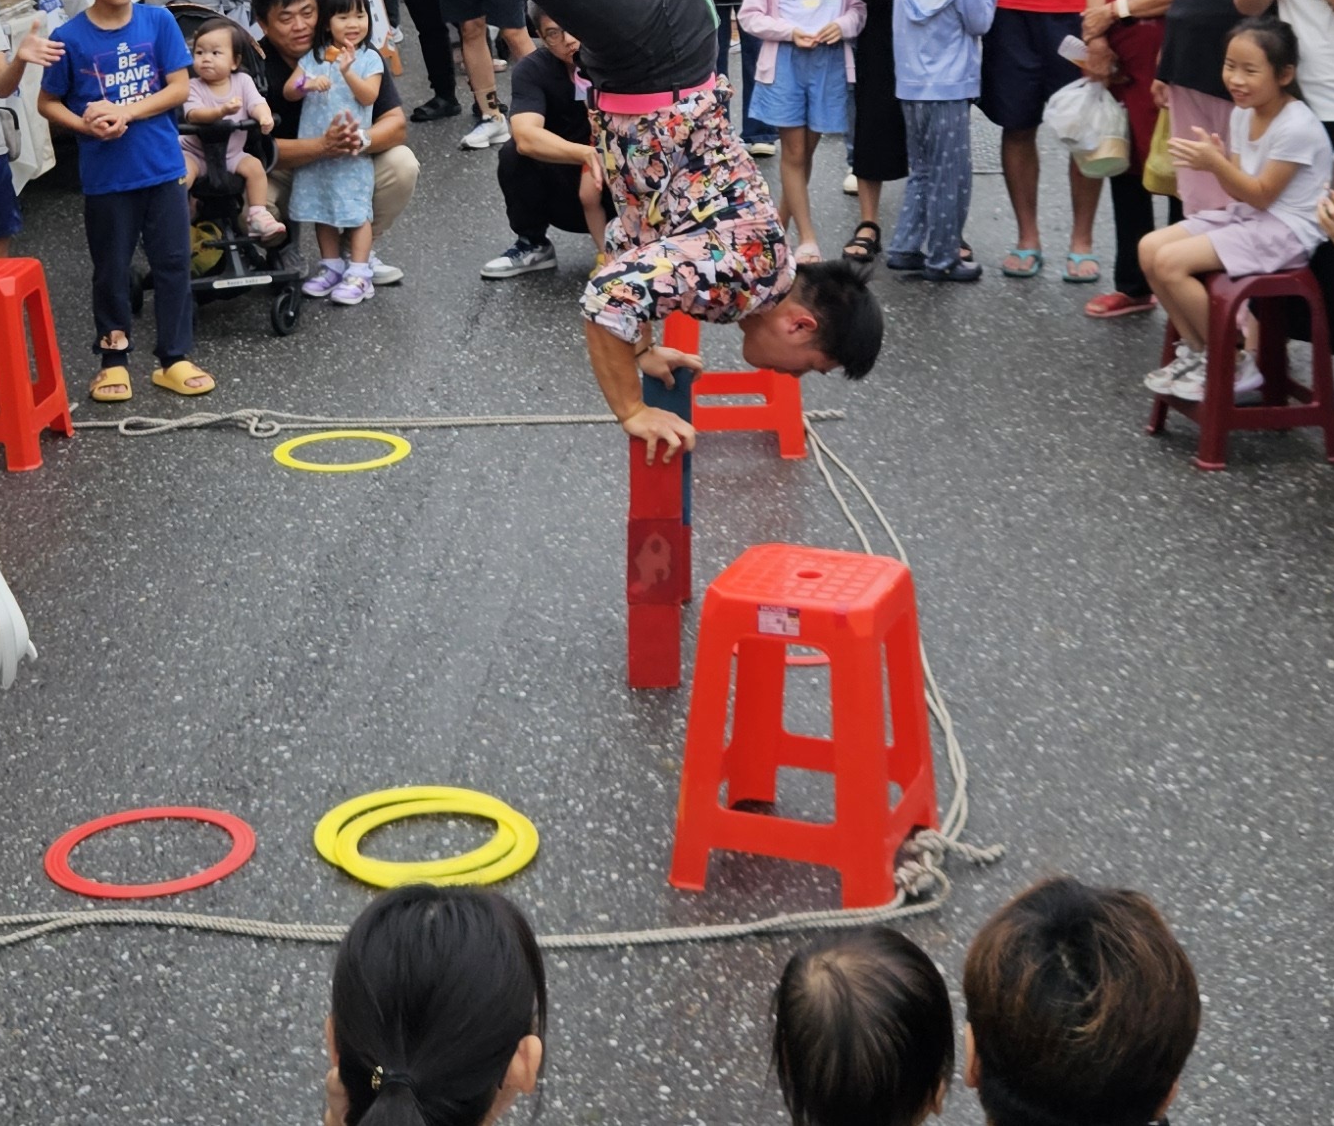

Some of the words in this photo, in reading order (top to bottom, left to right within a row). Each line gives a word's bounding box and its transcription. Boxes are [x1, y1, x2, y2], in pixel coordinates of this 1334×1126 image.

[118, 53, 138, 70] BE
[105, 64, 155, 88] BRAVE.
[119, 82, 138, 99] BE
[141, 80, 150, 93] A
